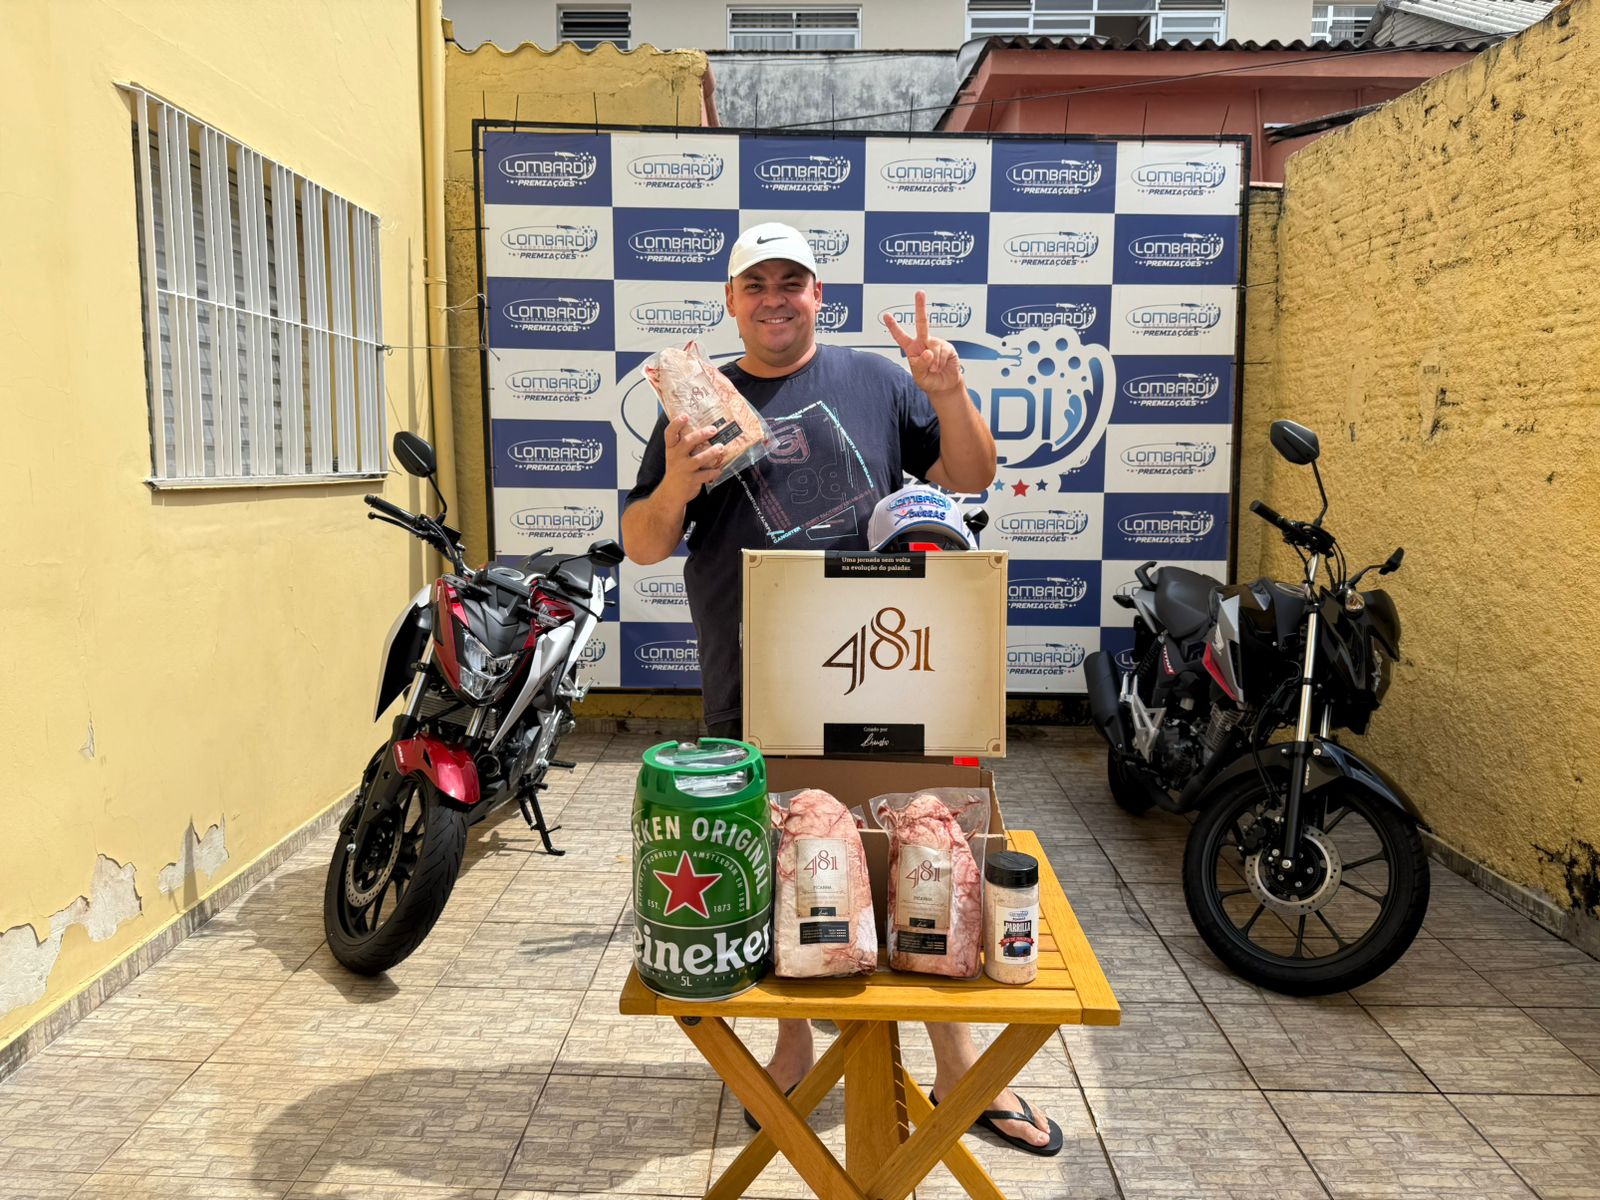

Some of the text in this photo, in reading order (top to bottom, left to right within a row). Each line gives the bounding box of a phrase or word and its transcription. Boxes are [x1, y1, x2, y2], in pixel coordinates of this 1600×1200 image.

[505, 160, 588, 174] LOMBARDI
[633, 162, 716, 176] LOMBARDI
[760, 165, 842, 179] LOMBARDI
[886, 166, 967, 180] LOMBARDI
[1013, 168, 1092, 182] LOMBARDI
[1138, 170, 1217, 184] LOMBARDI
[518, 179, 576, 188] PREMIAÇÕES
[645, 181, 704, 190] PREMIAÇÕES
[772, 183, 830, 192] PREMIAÇÕES
[898, 185, 955, 193] PREMIAÇÕES
[1024, 187, 1081, 195] PREMIAÇÕES
[1148, 188, 1205, 196] PREMIAÇÕES
[507, 233, 590, 247] LOMBARDI
[634, 236, 716, 250] LOMBARDI
[886, 240, 966, 253] LOMBARDI
[1010, 240, 1090, 254] LOMBARDI
[1136, 242, 1215, 255] LOMBARDI
[519, 252, 578, 260] PREMIAÇÕES
[647, 255, 705, 263] PREMIAÇÕES
[1021, 258, 1078, 266] PREMIAÇÕES
[896, 258, 953, 267] PREMIAÇÕES
[1146, 260, 1202, 268] PREMIAÇÕES
[510, 306, 591, 320] LOMBARDI
[637, 308, 716, 322] LOMBARDI
[1008, 312, 1087, 325] LOMBARDI
[1132, 312, 1212, 326] LOMBARDI
[522, 324, 580, 332] PREMIAÇÕES
[649, 326, 705, 334] PREMIAÇÕES
[1143, 329, 1199, 337] PREMIAÇÕES
[512, 377, 594, 391] LOMBARDI
[1130, 382, 1210, 395] LOMBARDI
[524, 394, 582, 402] PREMIAÇÕES
[514, 446, 595, 460] LOMBARDI
[1127, 450, 1206, 464] LOMBARDI
[526, 464, 583, 472] PREMIAÇÕES
[1138, 468, 1194, 476] PREMIAÇÕES
[516, 514, 596, 527] LOMBARDI
[1001, 518, 1079, 532] LOMBARDI
[1124, 518, 1204, 532] LOMBARDI
[528, 530, 584, 538] PREMIAÇÕES
[1012, 535, 1067, 543] PREMIAÇÕES
[1135, 535, 1191, 544] PREMIAÇÕES
[641, 582, 685, 593] LOMB
[1008, 586, 1077, 598] OMBARDI
[641, 648, 699, 659] LOMBA
[822, 607, 935, 695] 481
[1008, 652, 1076, 664] OMBARDI
[651, 664, 700, 672] PREMIAÇÕE
[692, 817, 769, 895] ORIGINAL
[693, 851, 739, 877] AMSTERDAM
[803, 849, 839, 879] 481
[905, 860, 941, 888] 481
[648, 900, 731, 912] EST. 1873
[680, 976, 692, 987] 5L
